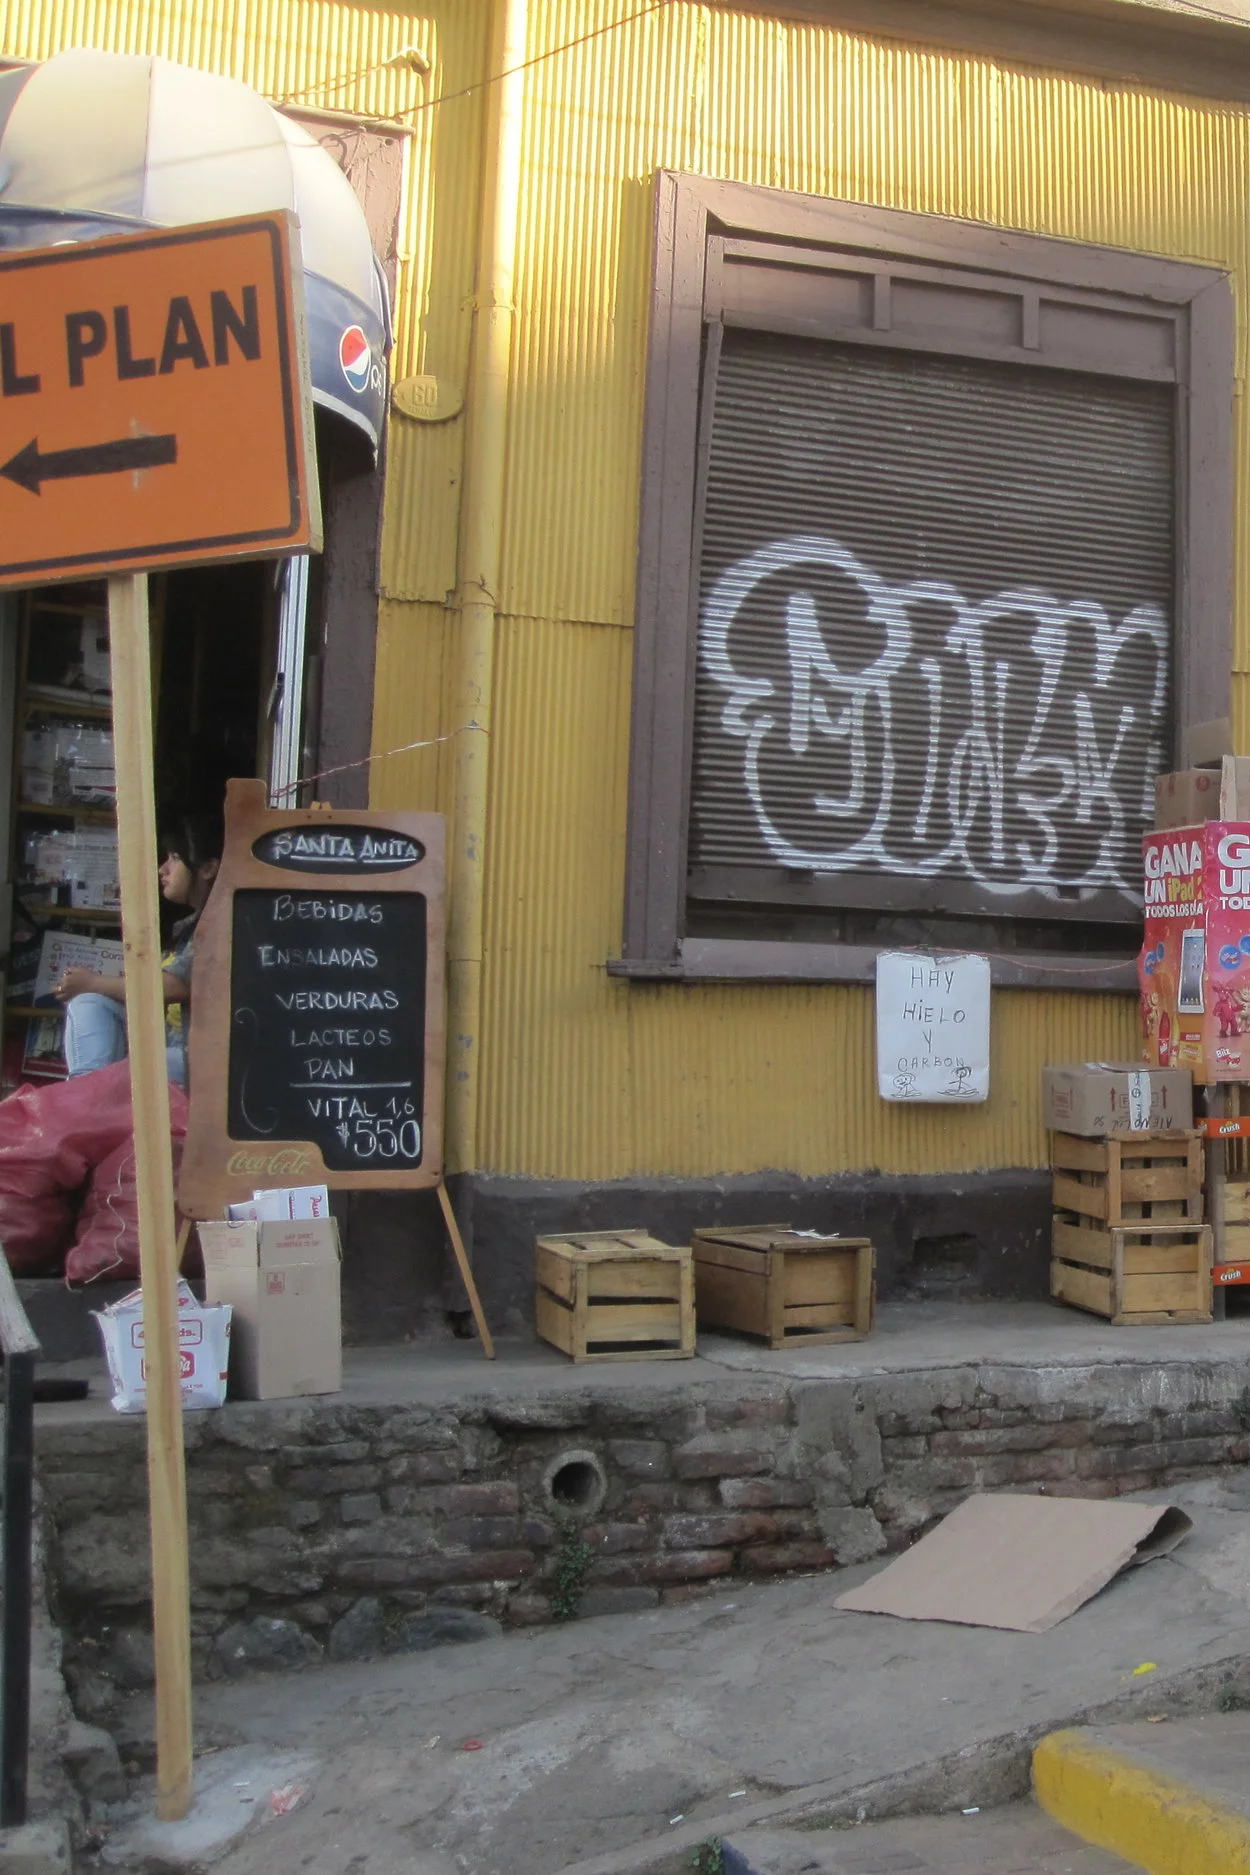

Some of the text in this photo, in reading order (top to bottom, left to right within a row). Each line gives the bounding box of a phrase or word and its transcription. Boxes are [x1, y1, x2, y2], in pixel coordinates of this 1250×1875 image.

[66, 284, 262, 389] PLAN
[274, 832, 356, 860] SANTA
[1144, 840, 1203, 879] GANA
[1144, 878, 1167, 904] UN
[1167, 876, 1195, 902] iPad
[1145, 902, 1175, 919] TODOS
[1175, 903, 1190, 917] LOS
[258, 944, 379, 969] ENSALADAS
[910, 966, 955, 994] HAY
[275, 989, 400, 1011] VERDURAS
[289, 1029, 393, 1047] LACTEOS
[922, 1029, 933, 1054] Y
[303, 1057, 355, 1080] PAN
[897, 1056, 967, 1073] CARBON
[308, 1097, 378, 1120] VITAL
[1219, 1122, 1240, 1135] Crush
[1220, 1270, 1241, 1282] Crush
